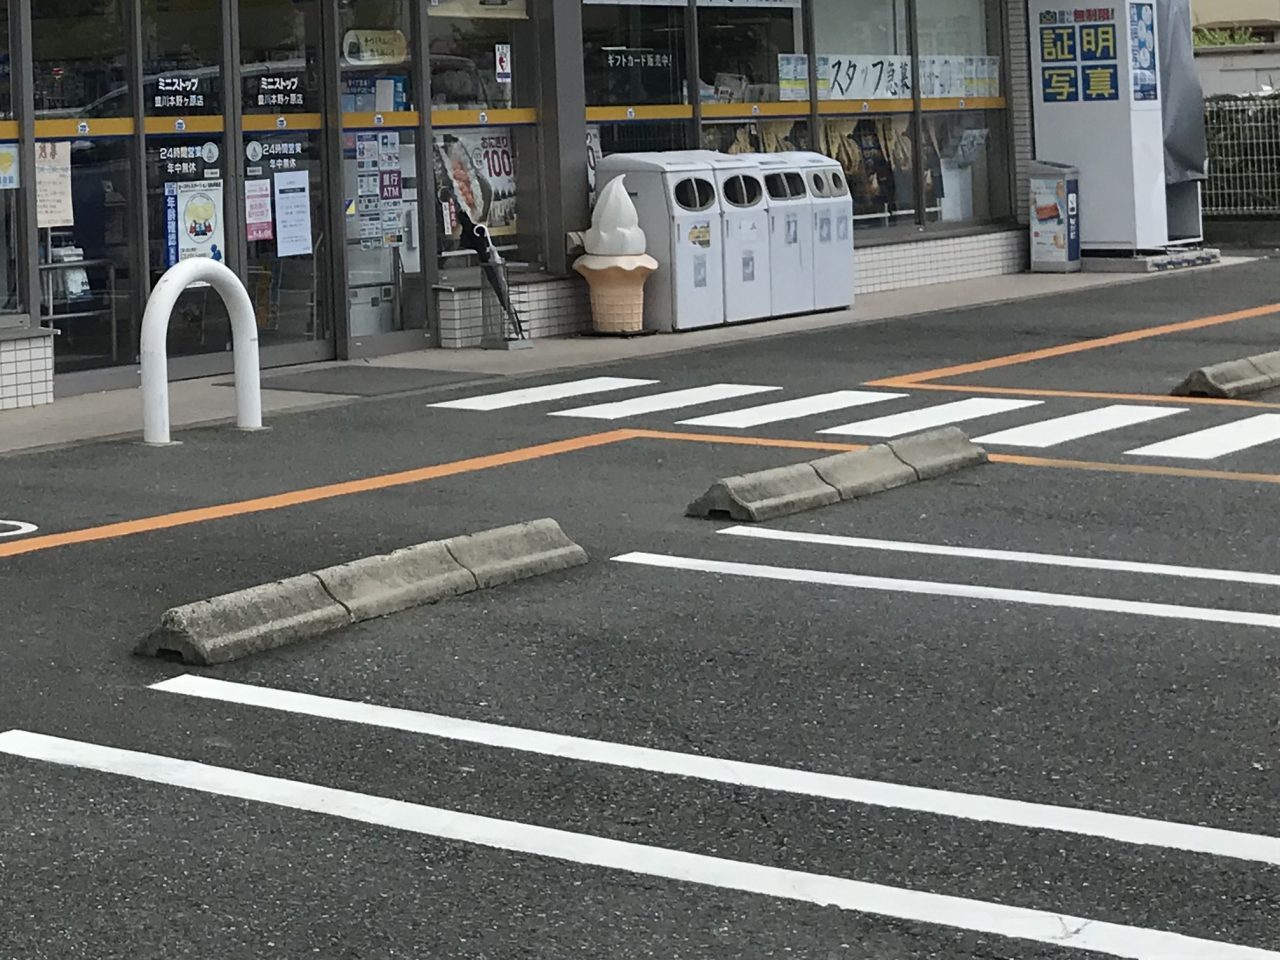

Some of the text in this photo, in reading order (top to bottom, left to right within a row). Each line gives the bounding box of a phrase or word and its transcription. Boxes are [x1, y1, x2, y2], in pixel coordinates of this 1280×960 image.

[1042, 26, 1115, 60] 証明
[158, 77, 199, 91] ミニストップ
[260, 76, 298, 90] ミニストップ
[1044, 67, 1116, 100] 写真
[382, 186, 400, 197] ATM
